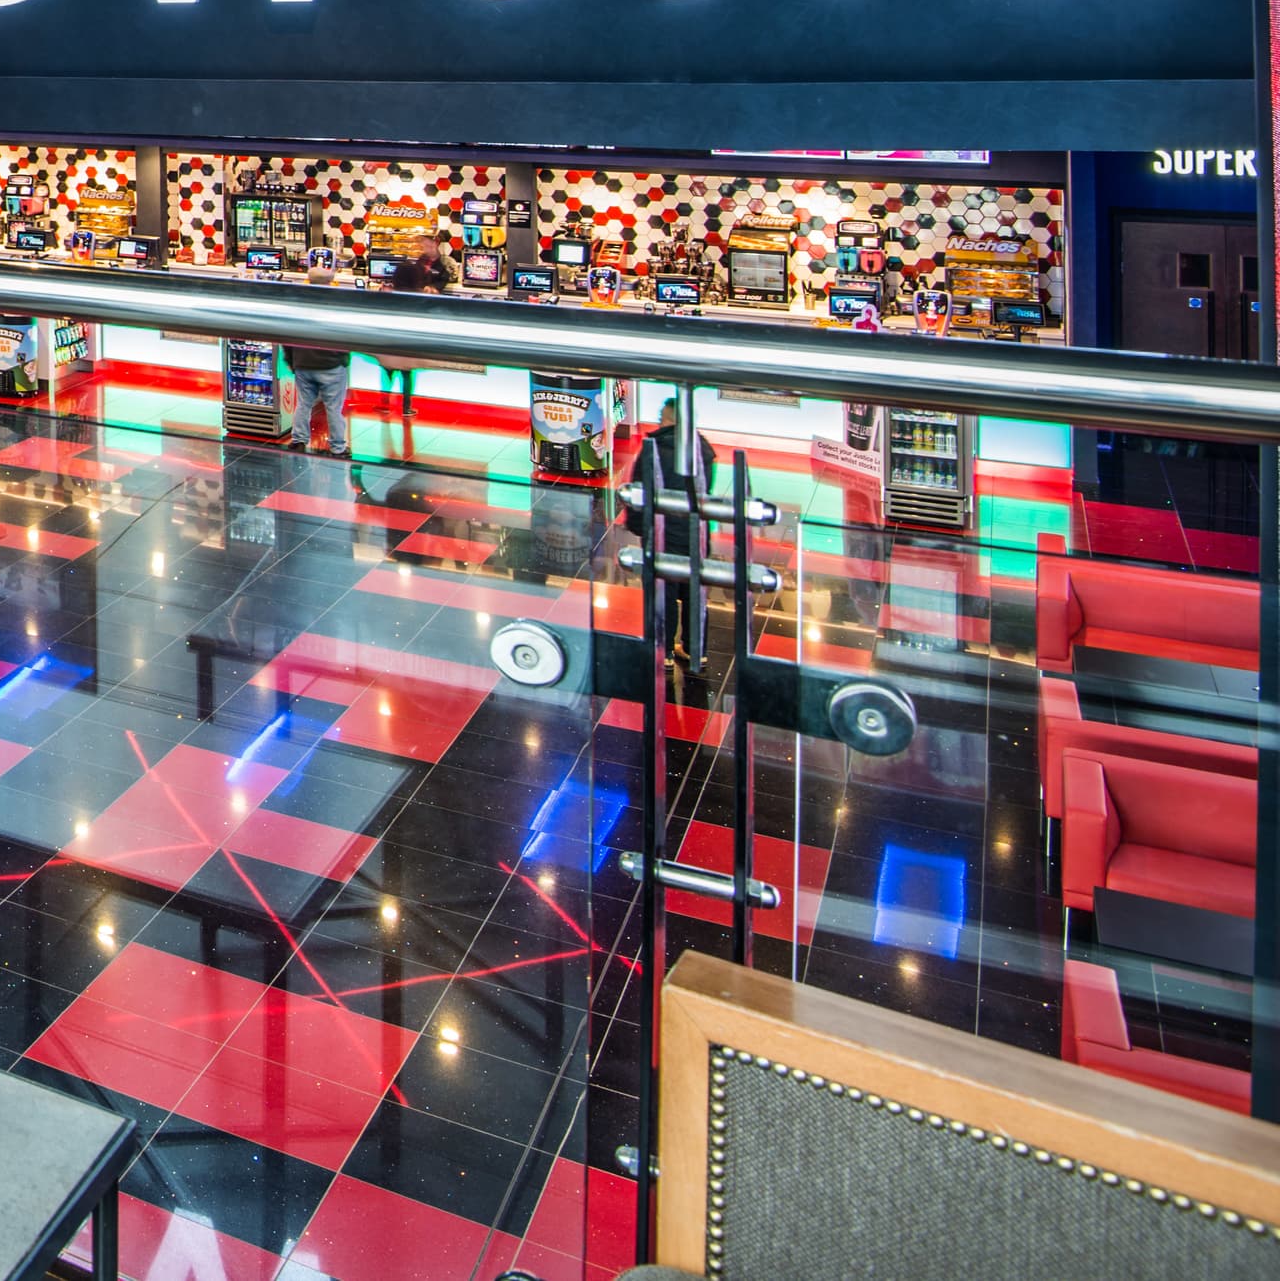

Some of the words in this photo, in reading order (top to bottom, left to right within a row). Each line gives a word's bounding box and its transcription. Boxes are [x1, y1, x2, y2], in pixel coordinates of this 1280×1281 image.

[79, 188, 124, 201] Nachos
[371, 204, 425, 219] Nachos
[742, 214, 795, 226] Rollover
[947, 237, 1021, 254] Nachos
[543, 412, 573, 423] TUB!
[817, 441, 839, 453] Collect
[839, 448, 852, 456] your
[853, 451, 873, 462] Justice
[840, 455, 857, 465] whilst
[858, 461, 877, 471] stocks
